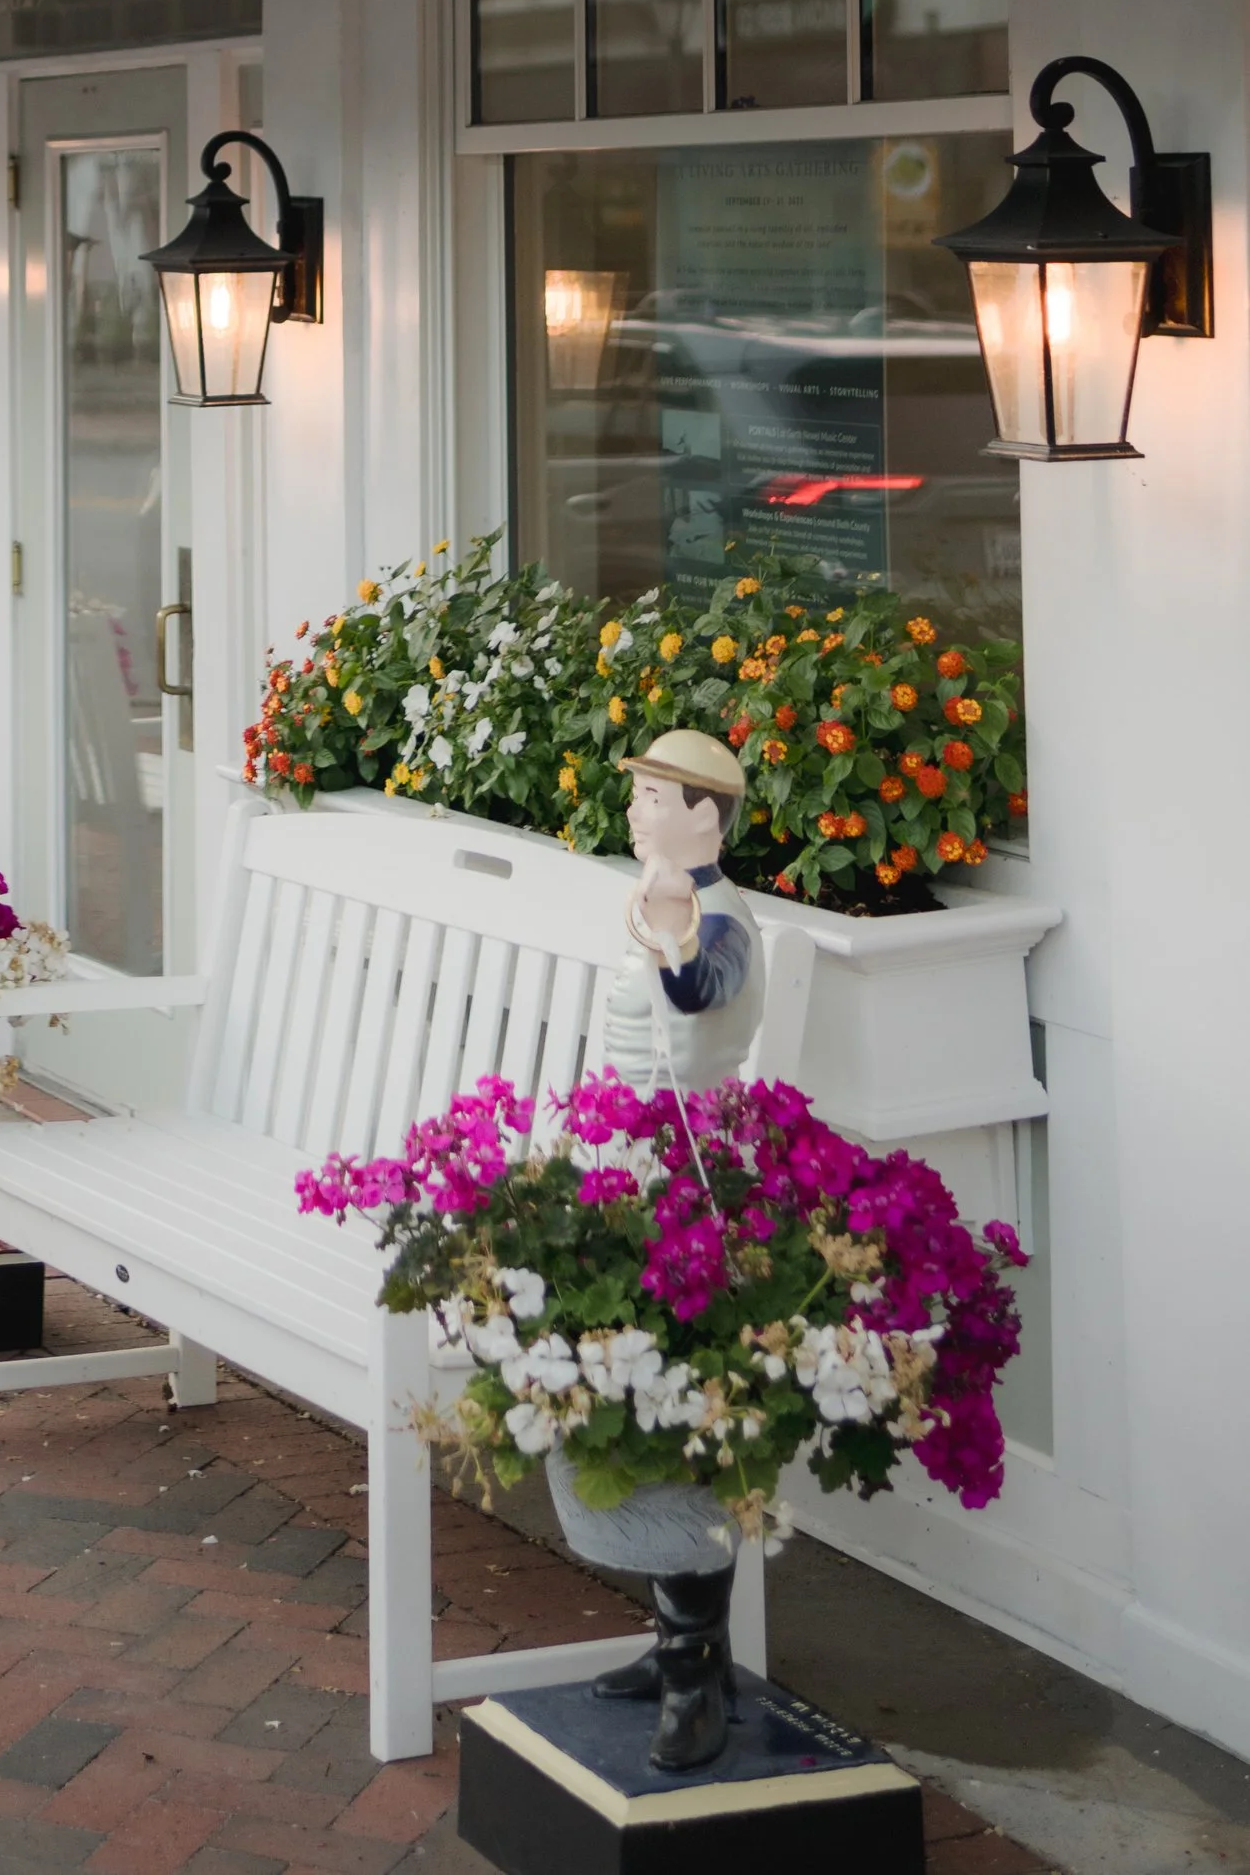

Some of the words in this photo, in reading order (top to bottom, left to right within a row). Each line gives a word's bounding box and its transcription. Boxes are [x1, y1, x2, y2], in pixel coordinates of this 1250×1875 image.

[690, 164, 734, 179] LIVING
[742, 162, 770, 178] ARTS
[776, 160, 859, 178] GATHERING
[779, 384, 801, 393] VISUAL
[803, 385, 820, 395] ARTS
[830, 386, 879, 398] STORYTELLING
